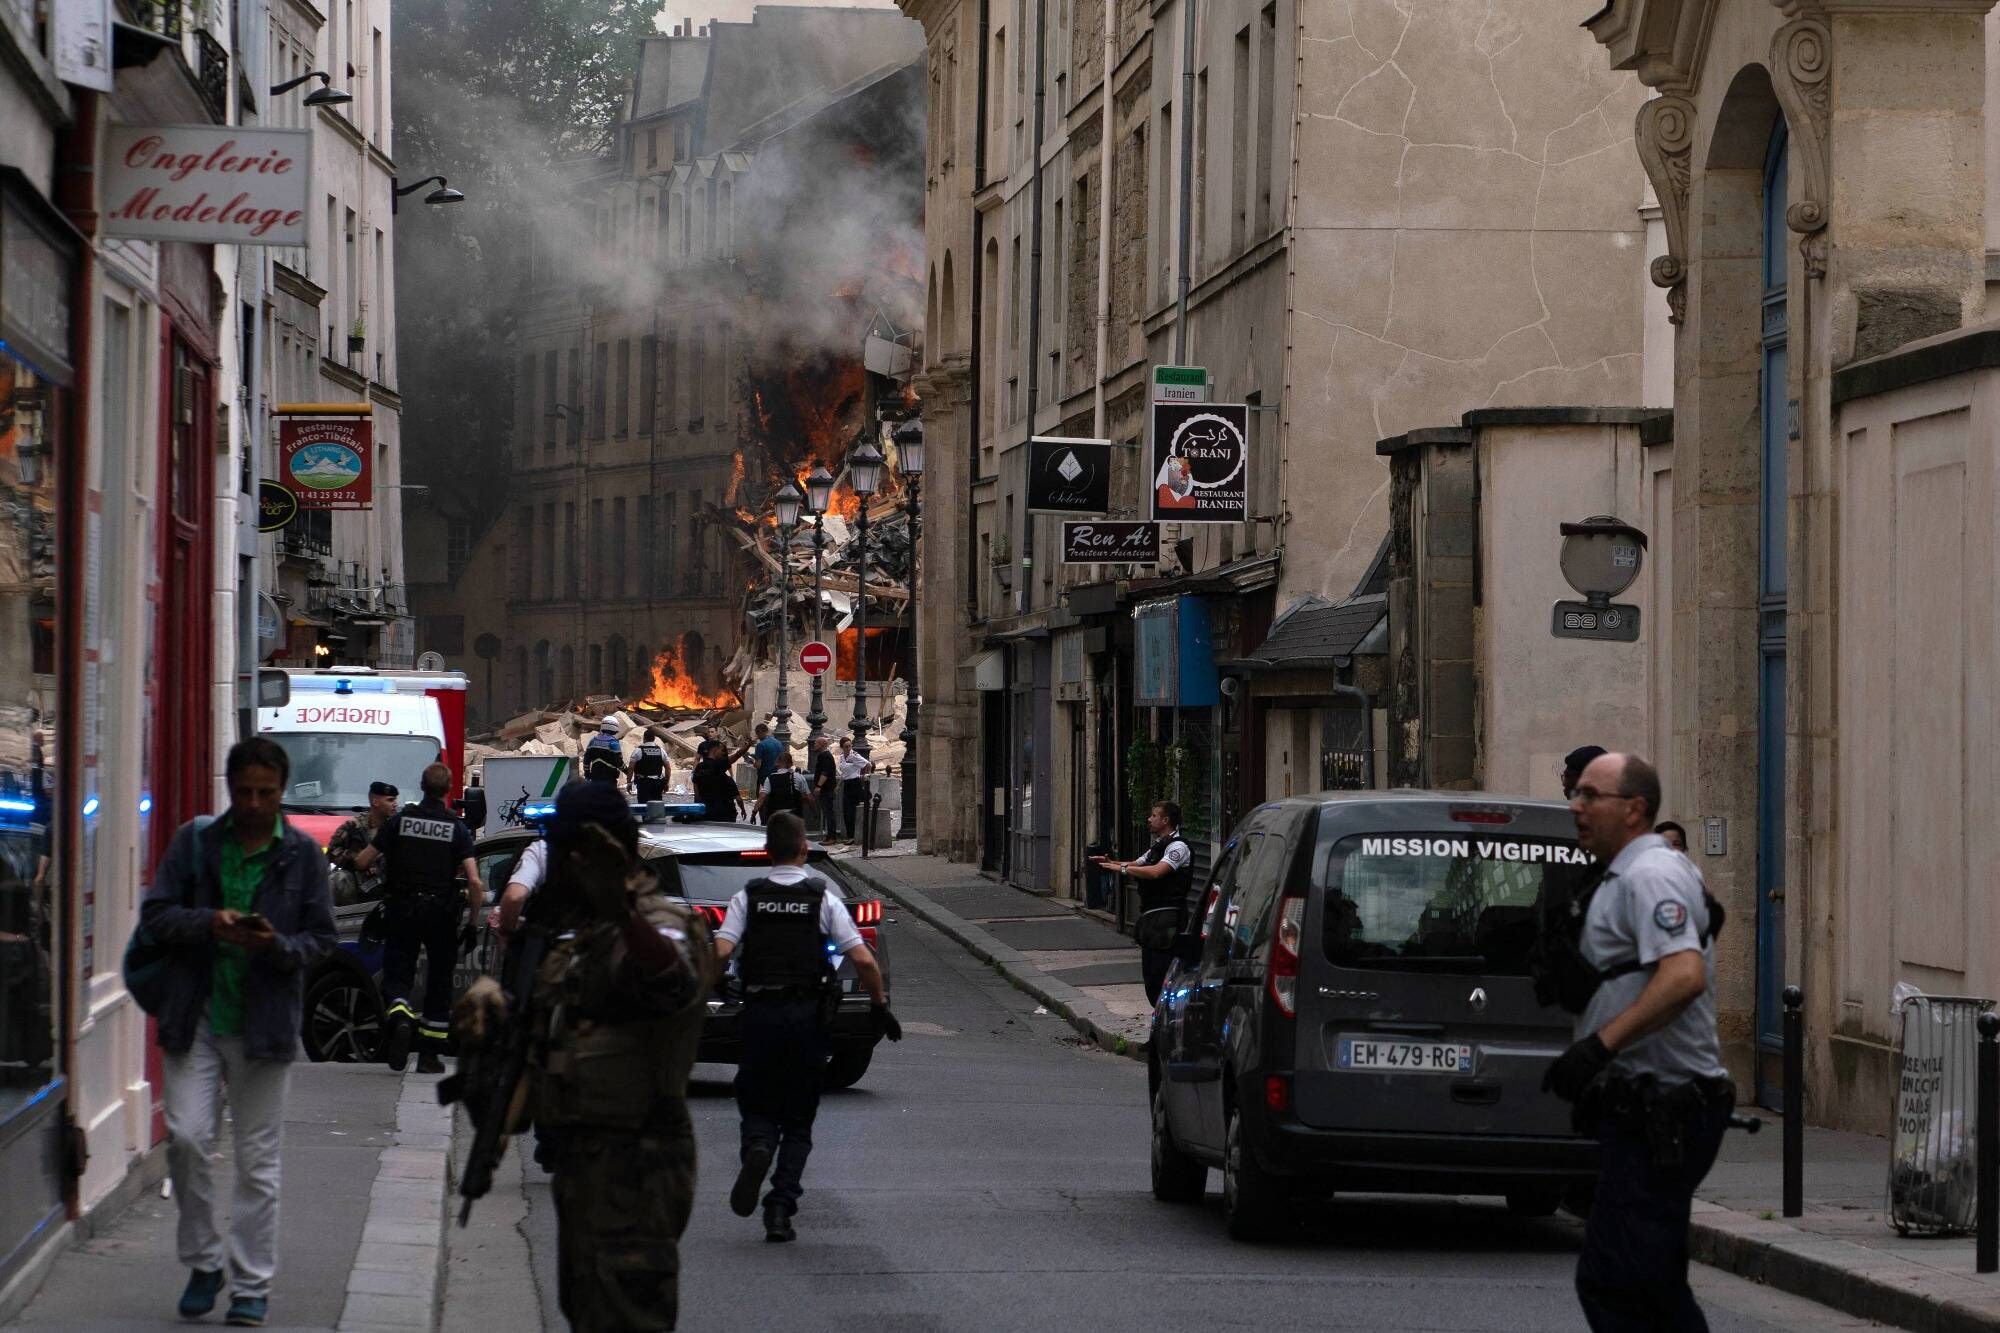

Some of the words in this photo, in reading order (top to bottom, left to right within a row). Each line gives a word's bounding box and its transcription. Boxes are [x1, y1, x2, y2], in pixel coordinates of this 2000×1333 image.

[123, 135, 293, 182] Onglerie
[109, 186, 304, 237] Modelage
[1163, 387, 1196, 399] Iranien
[297, 423, 355, 436] Restaurant
[286, 432, 365, 454] Franco-Tibétain
[307, 491, 318, 499] 43
[320, 491, 330, 499] 25
[333, 491, 343, 499] 92
[345, 491, 356, 499] 72
[1194, 490, 1245, 498] RESTAURANT
[1197, 500, 1244, 509] IRANIEN
[1071, 525, 1116, 547] Ren
[1121, 525, 1152, 547] Ai
[1067, 547, 1108, 557] Traiteur
[1109, 548, 1156, 559] Asiatique
[403, 818, 451, 838] POLICE
[1362, 838, 1469, 858] MISSION
[1477, 841, 1597, 865] VIGIPIRA
[757, 901, 809, 914] POLICE
[1353, 1044, 1456, 1067] EM-479-RG
